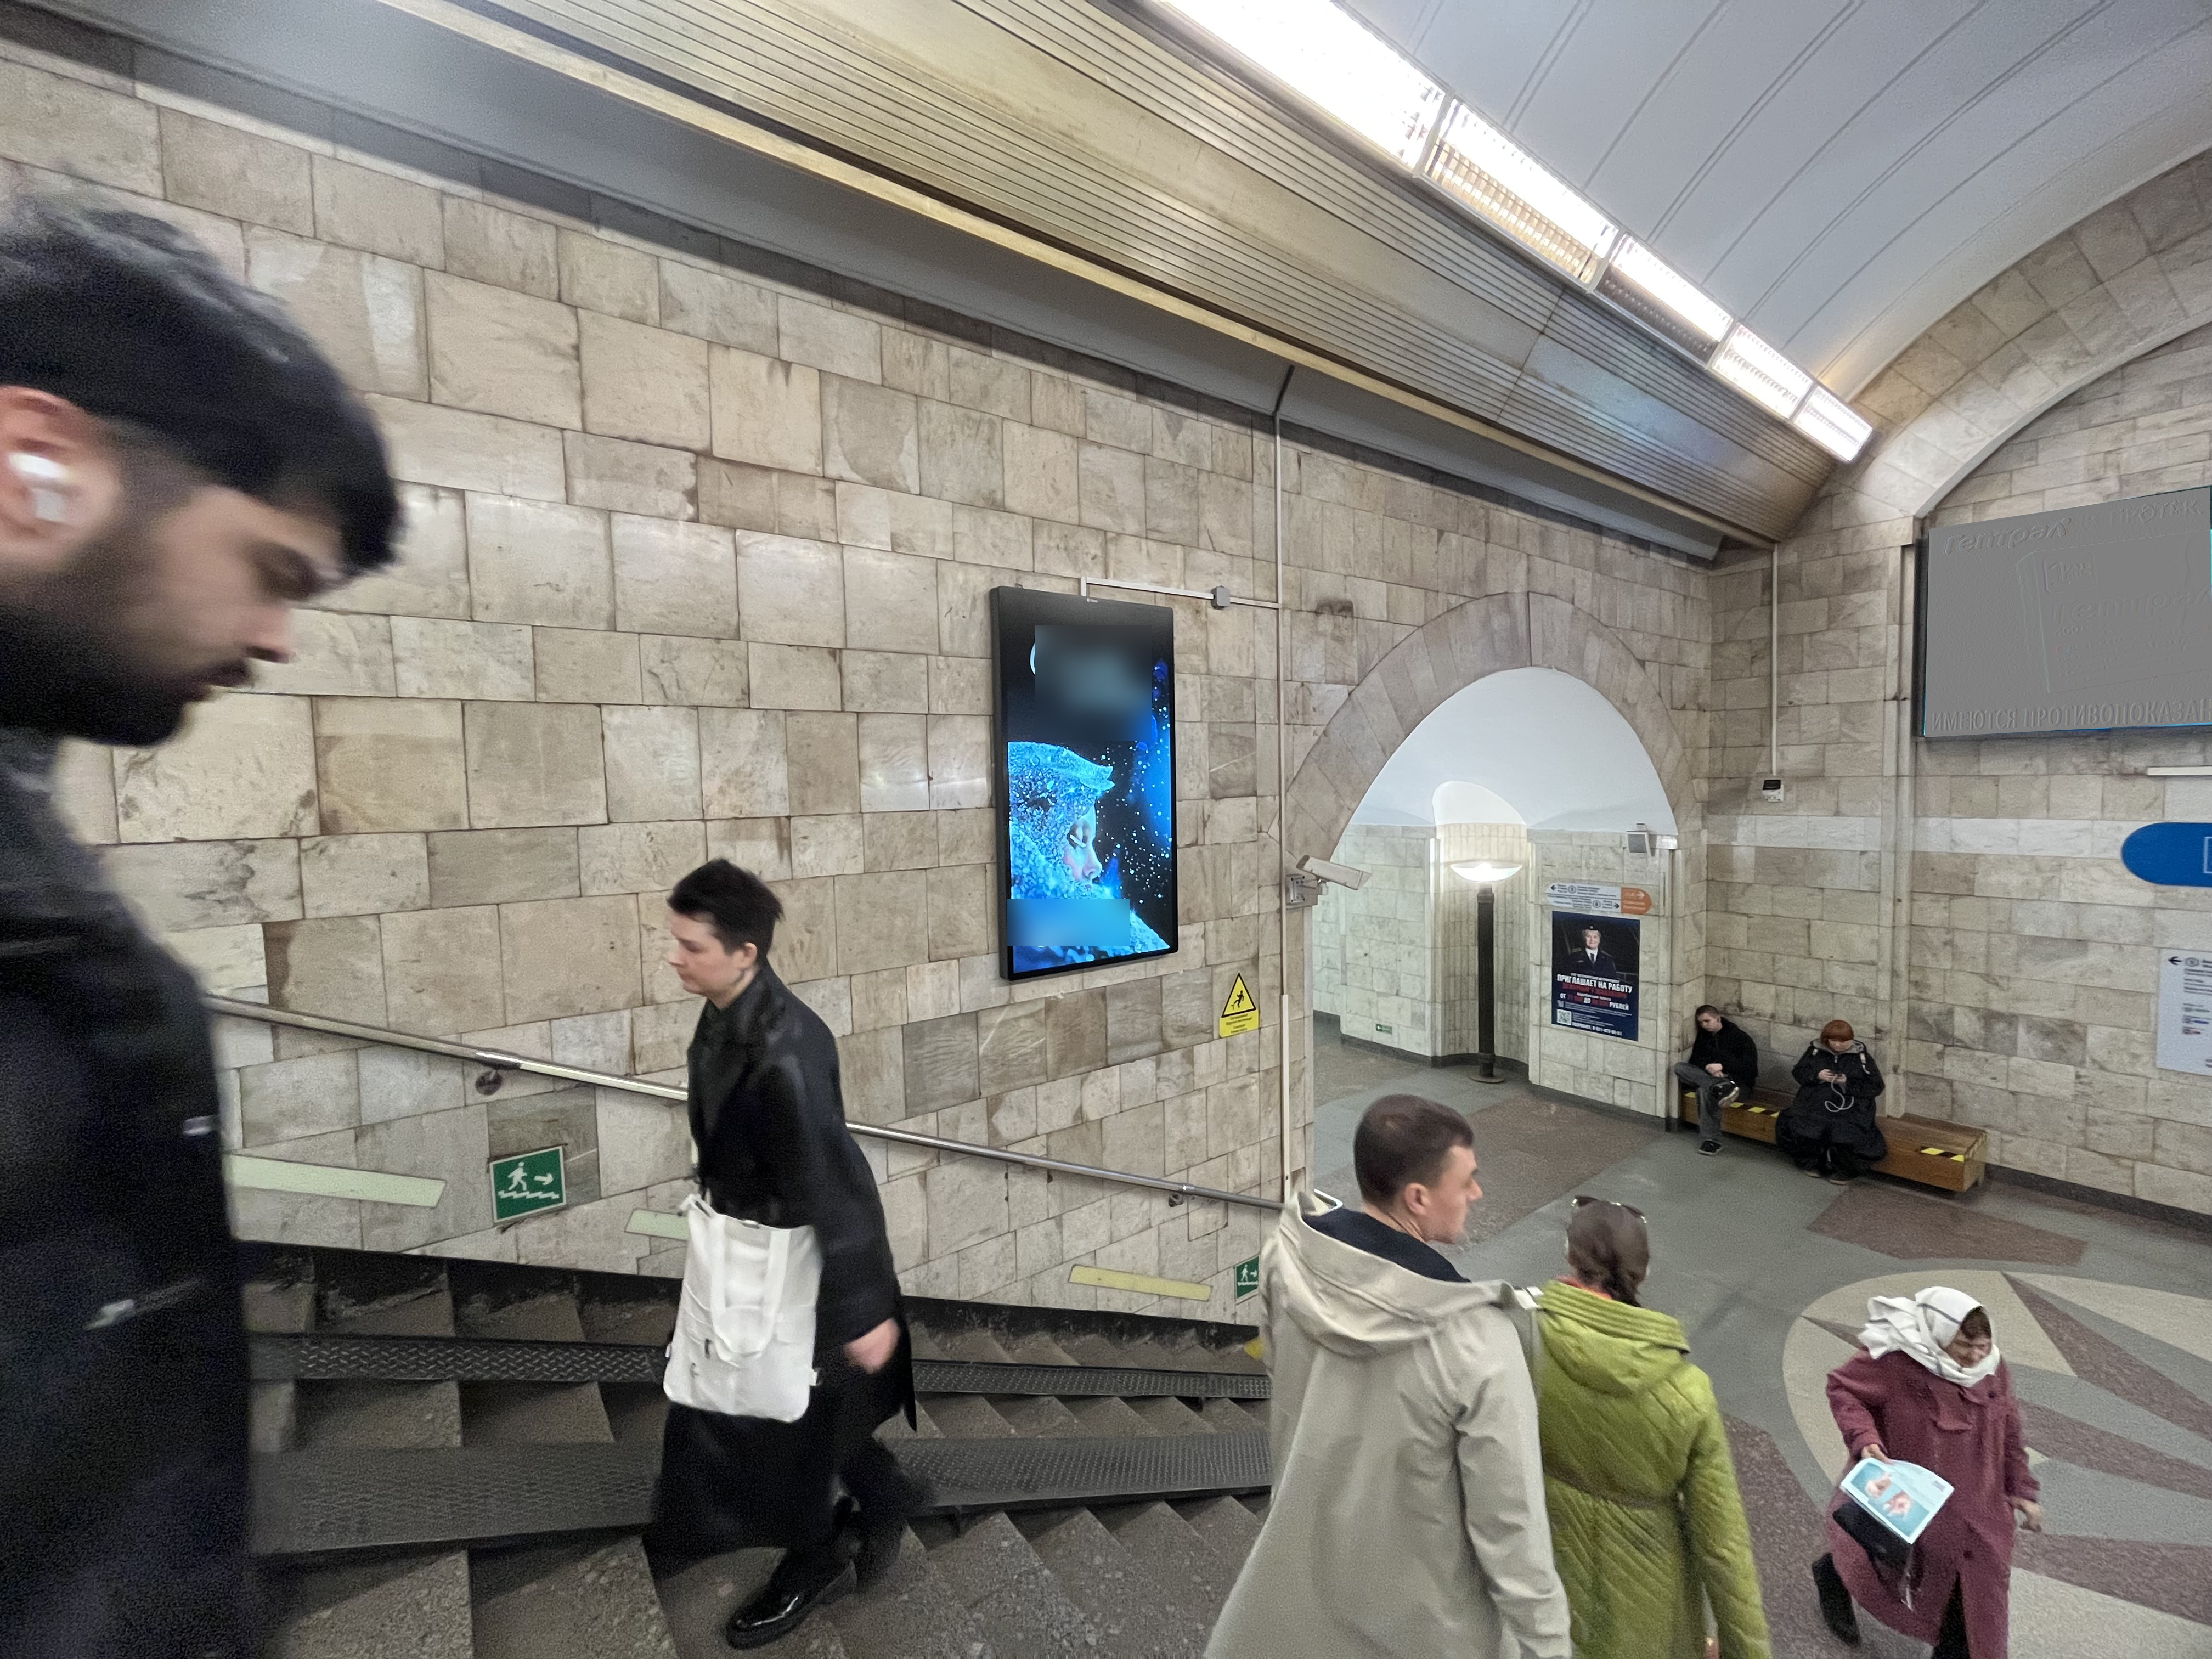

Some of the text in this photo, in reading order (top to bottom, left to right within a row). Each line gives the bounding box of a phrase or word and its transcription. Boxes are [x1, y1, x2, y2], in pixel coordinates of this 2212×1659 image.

[1932, 708, 2018, 731] ИМЕЮТСЯ
[1556, 974, 1596, 988] ПРИГЛАШАЕТ
[1598, 981, 1607, 990] НА
[1608, 983, 1633, 994] РАБОТУ
